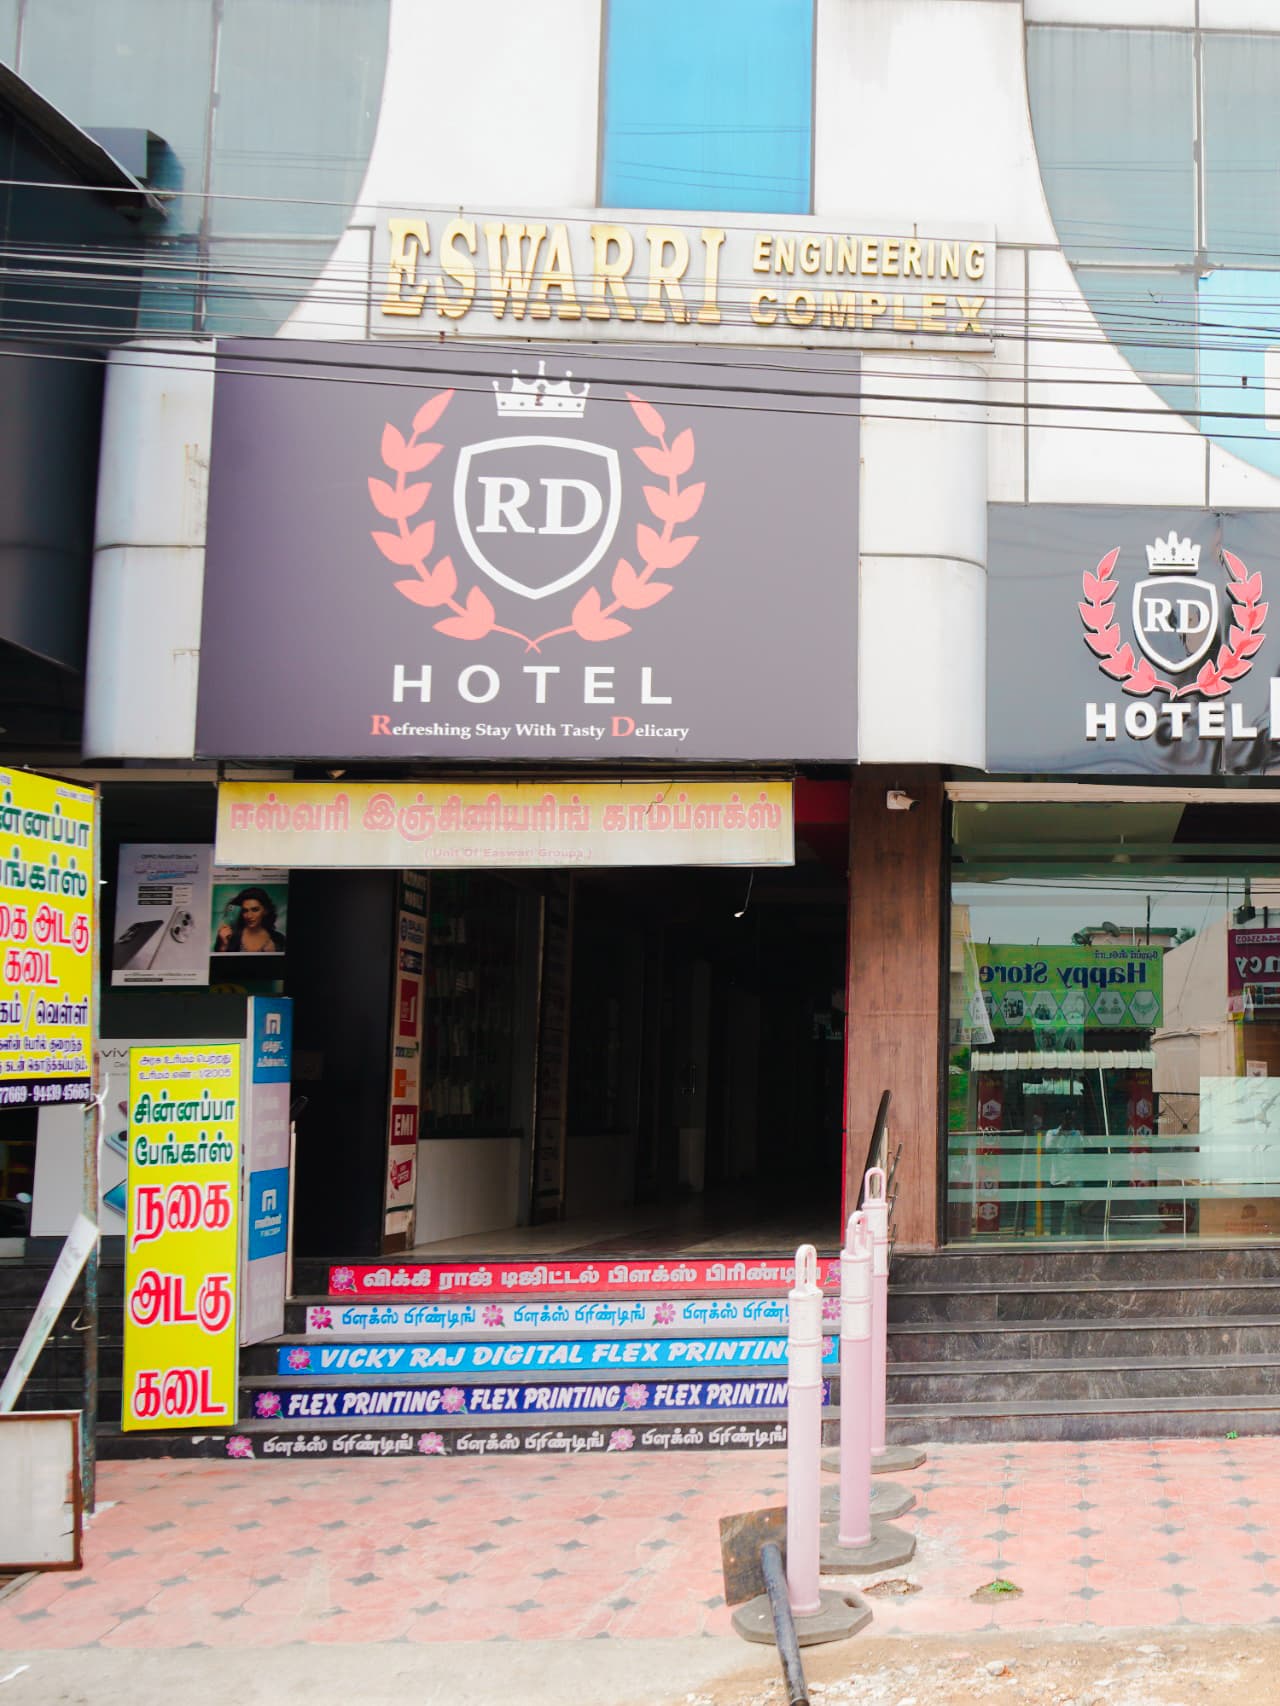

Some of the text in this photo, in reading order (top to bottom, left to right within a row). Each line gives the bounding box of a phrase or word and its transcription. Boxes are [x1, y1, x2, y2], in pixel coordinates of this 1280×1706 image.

[381, 218, 727, 325] ESWARRI
[752, 233, 986, 280] ENGINEERING
[750, 288, 986, 334] COMPLEX
[476, 476, 604, 536] RD
[1143, 597, 1213, 635] RD
[392, 664, 673, 705] HOTEL
[370, 714, 690, 742] Refreshing Stay With Tasty Delicary
[1083, 701, 1259, 742] HOTEL
[231, 792, 350, 831] ஈஸ்வரி
[602, 792, 783, 831] காம்ப்ளக்ஸ்
[6, 949, 59, 984] கடை
[101, 1047, 128, 1058] viv
[133, 1089, 236, 1125] சின்னப்பா
[394, 1113, 414, 1137] EMI
[134, 1131, 234, 1166] பேங்கர்ஸ்
[132, 1183, 231, 1251] நகை
[363, 1268, 432, 1288] விக்கி
[438, 1267, 493, 1291] ராஜ்
[501, 1264, 600, 1288] டிஜிட்டல்
[607, 1263, 698, 1284] பிளக்ஸ்
[131, 1270, 232, 1333] அடகு
[513, 1302, 646, 1328] பிளக்ஸ் பிரிண்டிங்
[682, 1301, 738, 1325] பிளக்ஸ்
[341, 1305, 476, 1330] பிளக்ஸ் பிரிண்டிங்
[321, 1340, 790, 1368] VICKY RAJ DIGITAL FLEX PRINTIN
[133, 1369, 226, 1419] கடை
[288, 1390, 441, 1416] FLEX PRINTING
[470, 1385, 621, 1411] FLEX PRINTING
[654, 1382, 789, 1407] FLEX PRINTIN
[263, 1433, 413, 1457] பிளக்ஸ் பிரிண்டிங்
[456, 1430, 604, 1455] பிளக்ஸ் பிரிண்டிங்
[641, 1427, 703, 1450] பிளக்ஸ்
